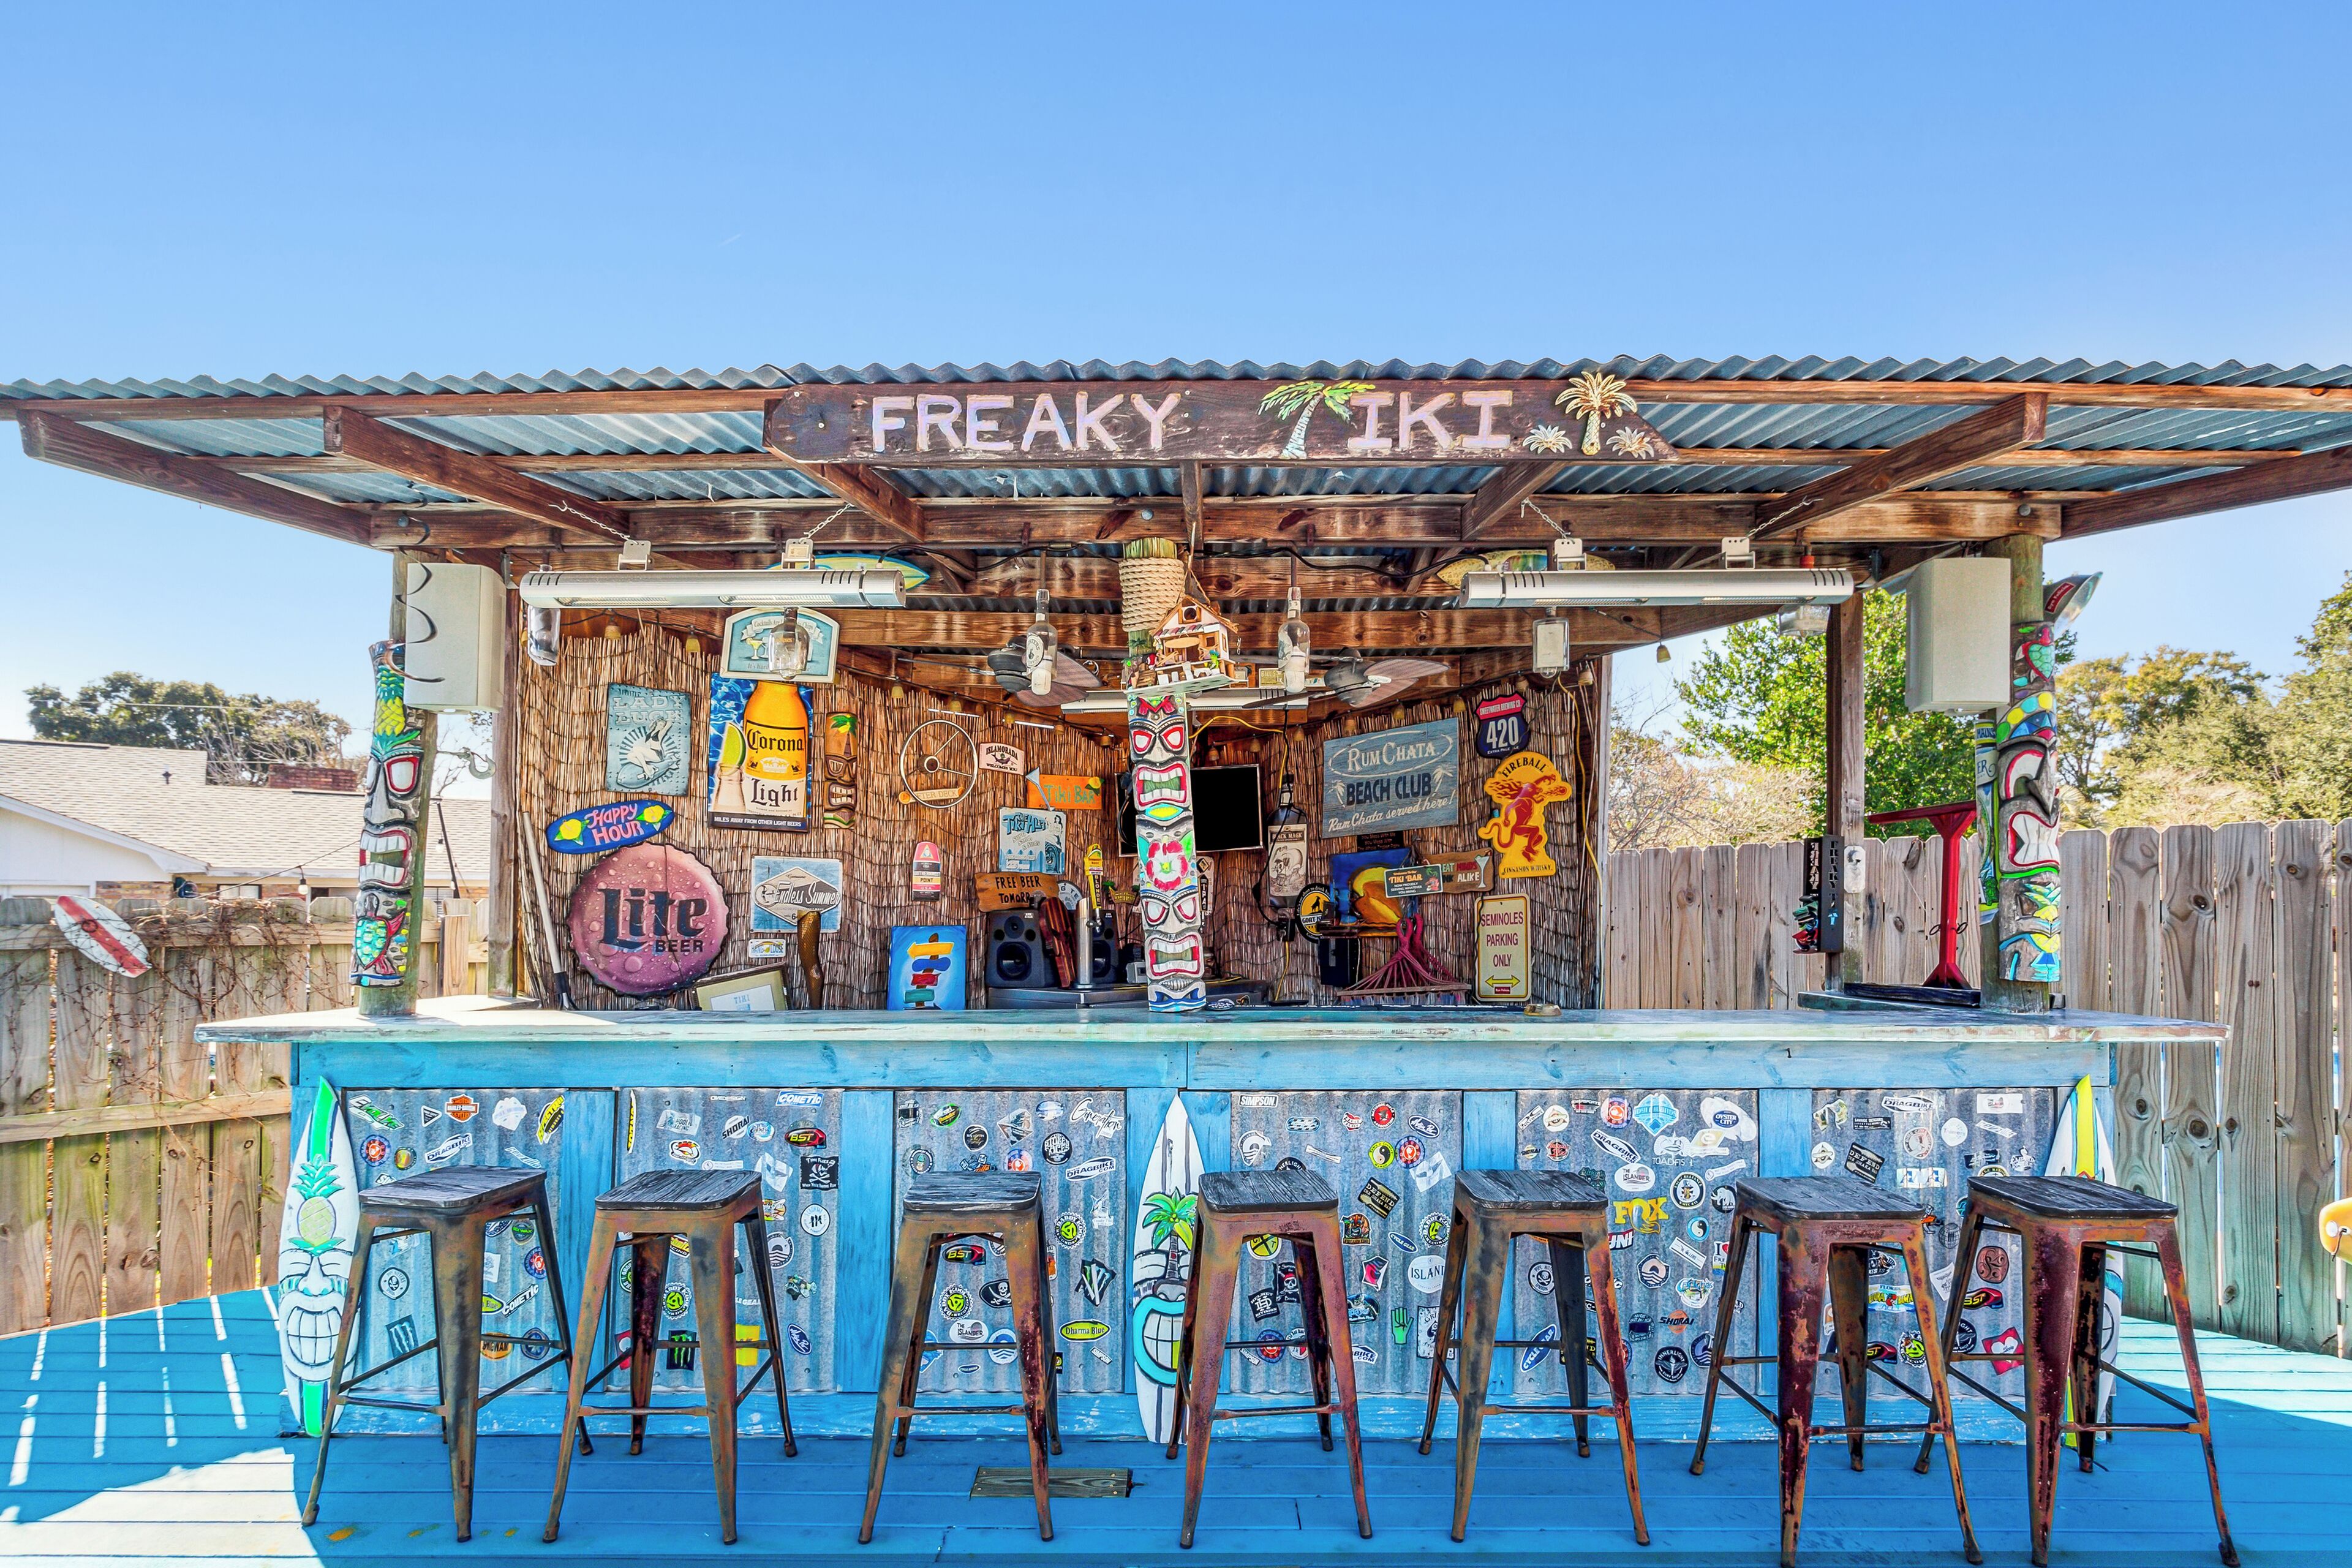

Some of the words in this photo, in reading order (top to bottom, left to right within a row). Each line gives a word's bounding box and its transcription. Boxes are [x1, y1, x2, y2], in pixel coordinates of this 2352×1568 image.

[872, 392, 1181, 453] FREAKY
[614, 696, 685, 709] LADY
[1480, 704, 1501, 715] SWEETWATER
[1501, 701, 1515, 711] BREWING
[616, 710, 683, 725] LUCK
[1487, 717, 1519, 748] 420
[747, 728, 804, 753] Corona
[986, 745, 1018, 760] ISLAMORADA
[1502, 757, 1544, 778] FIREBALL
[751, 778, 798, 807] Light
[1346, 778, 1390, 806] BEACH
[1395, 773, 1431, 799] CLUB
[1386, 799, 1421, 820] served
[1422, 790, 1457, 811] here!
[592, 821, 644, 845] HOUR
[1441, 863, 1455, 872] EAT
[1456, 862, 1477, 871] MINDS
[1828, 841, 1838, 888] FREAKY
[995, 876, 1016, 889] FREE
[1020, 875, 1041, 888] BEER
[1457, 872, 1480, 883] ALIKE
[774, 881, 804, 904] Endless
[805, 881, 840, 905] Summer
[998, 893, 1030, 903] TOMORR
[597, 888, 707, 949] Lite
[1480, 911, 1523, 927] SEMINOLES
[655, 940, 703, 952] BEER
[1487, 932, 1518, 947] PARKING
[1493, 954, 1512, 967] ONLY
[734, 995, 750, 1004] TIKI
[778, 1093, 821, 1105] COMETIC
[1240, 1095, 1275, 1106] SIMPSON
[1883, 1099, 1934, 1108] DRAGBIKE
[722, 1116, 749, 1139] SHORAI
[790, 1133, 814, 1142] BST
[427, 1135, 471, 1161] DRAGBIKE
[1044, 1144, 1070, 1155] FACES
[1593, 1133, 1638, 1162] DRAGBIKE
[1849, 1150, 1880, 1170] DEFEND
[1856, 1159, 1871, 1171] SHAKA
[1067, 1161, 1114, 1178] DRAGBIKE
[1366, 1183, 1395, 1206] DEFEND
[1371, 1194, 1383, 1205] SHAKA
[1613, 1197, 1669, 1230] FOX
[1390, 1234, 1403, 1245] CYCLE
[1403, 1242, 1415, 1251] GEAR
[1716, 1243, 1721, 1255] I
[948, 1250, 971, 1259] BST
[1535, 1283, 1548, 1292] UNION
[486, 1300, 499, 1309] Blue
[502, 1284, 539, 1315] COMETIC
[1251, 1292, 1273, 1304] HELMET
[1255, 1308, 1277, 1317] DIVISION
[1659, 1316, 1695, 1326] SHORAI
[1091, 1326, 1105, 1335] Blue
[1091, 1348, 1112, 1364] SIMPSON
[1240, 1348, 1261, 1365] SIMPSON
[1657, 1349, 1685, 1362] INNERLIGHT
[1867, 1347, 1881, 1355] ST
[1523, 1349, 1540, 1370] CYCLE
